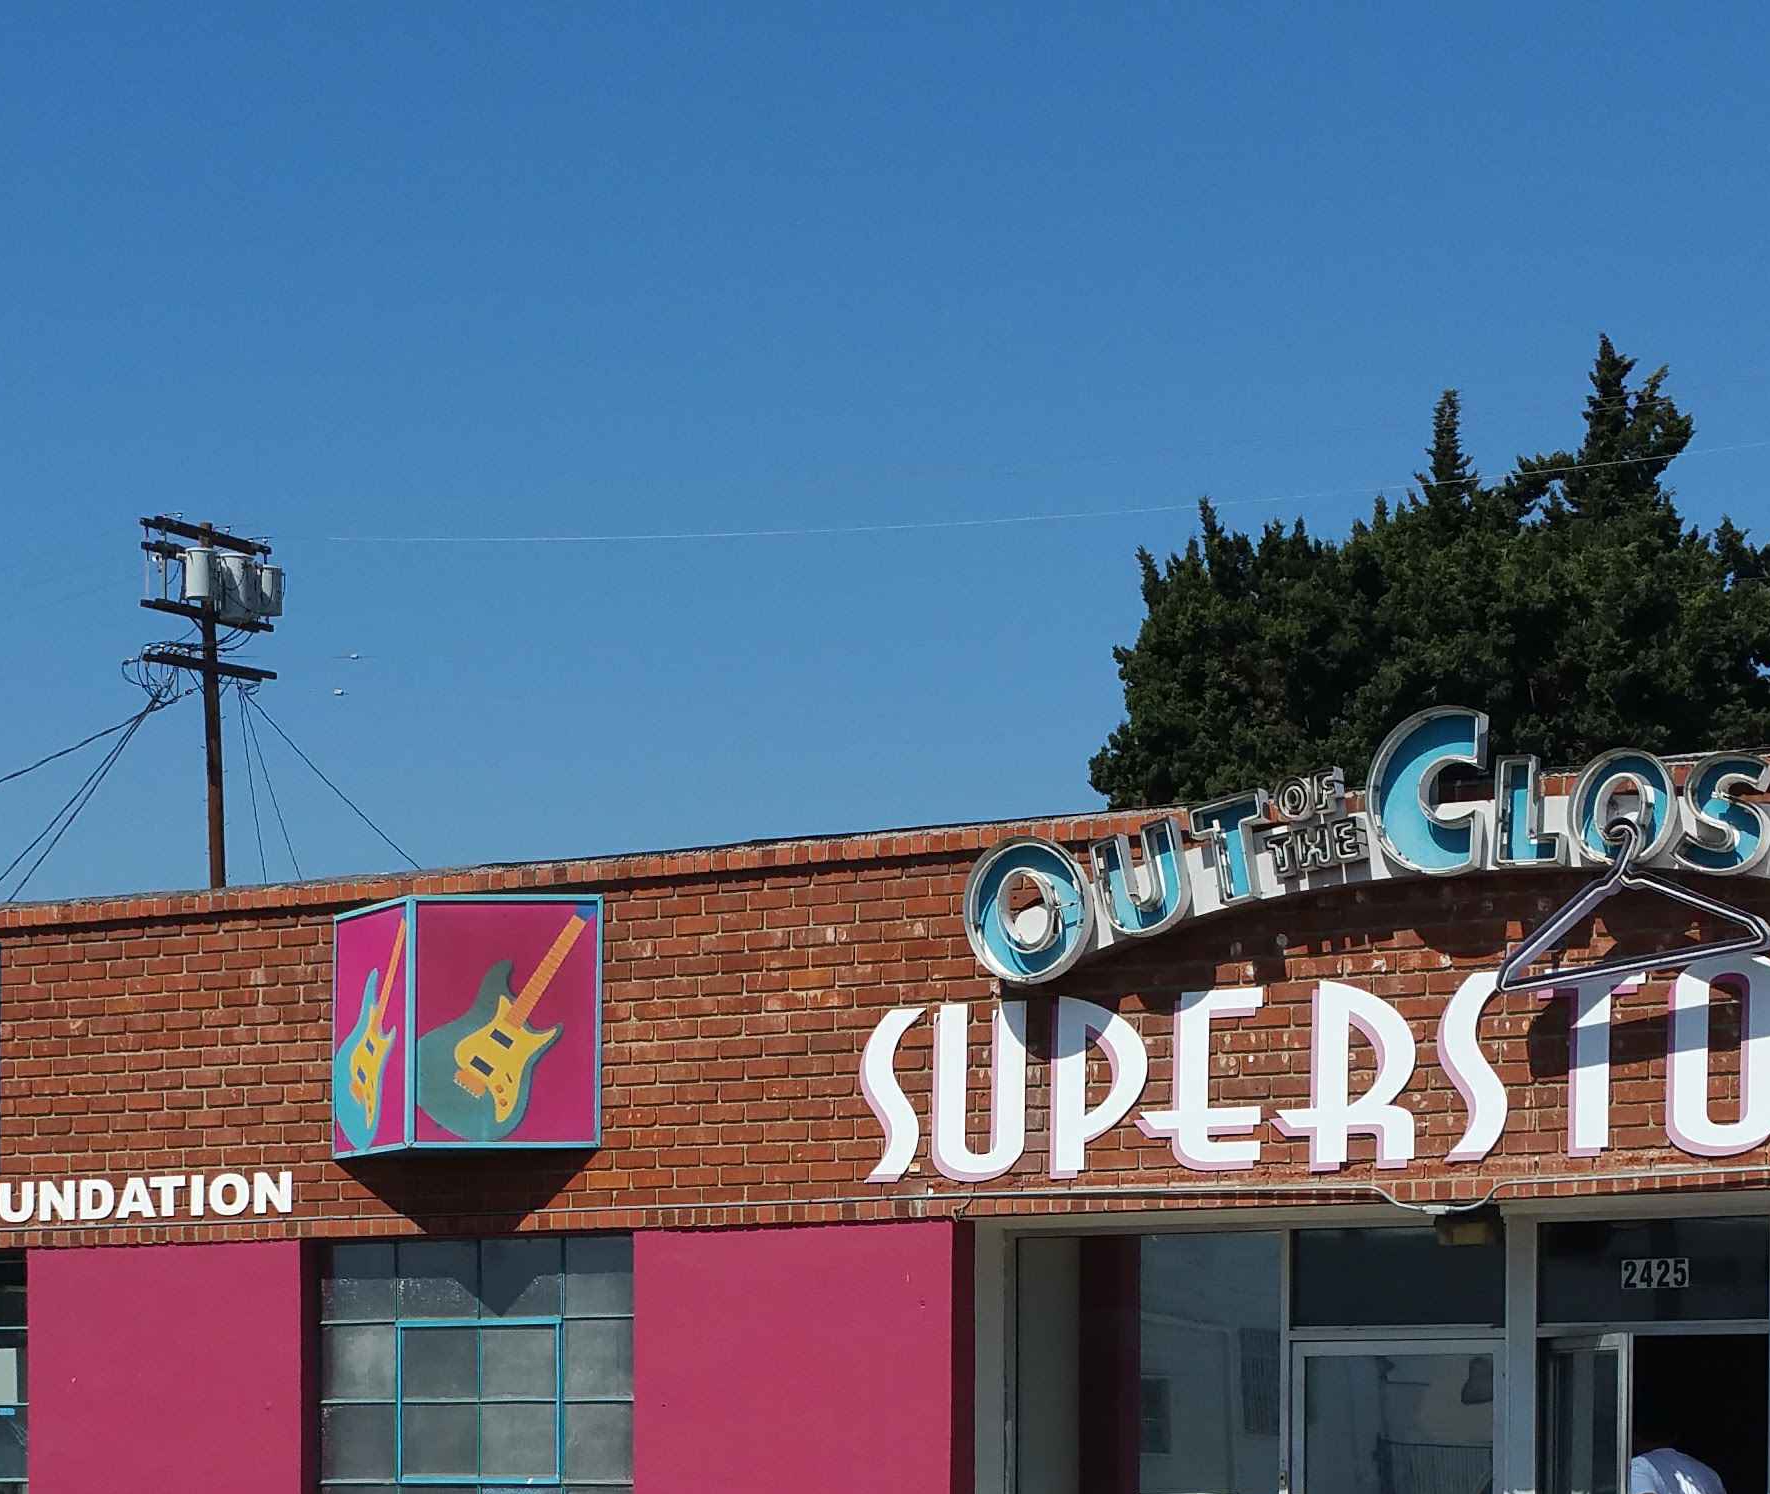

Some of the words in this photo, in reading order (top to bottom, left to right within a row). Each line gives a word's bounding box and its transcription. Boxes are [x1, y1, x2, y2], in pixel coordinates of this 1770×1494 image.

[1276, 765, 1346, 824] OF
[1265, 814, 1371, 880] THE
[964, 786, 1269, 985] OUT
[1623, 1258, 1688, 1288] 2425
